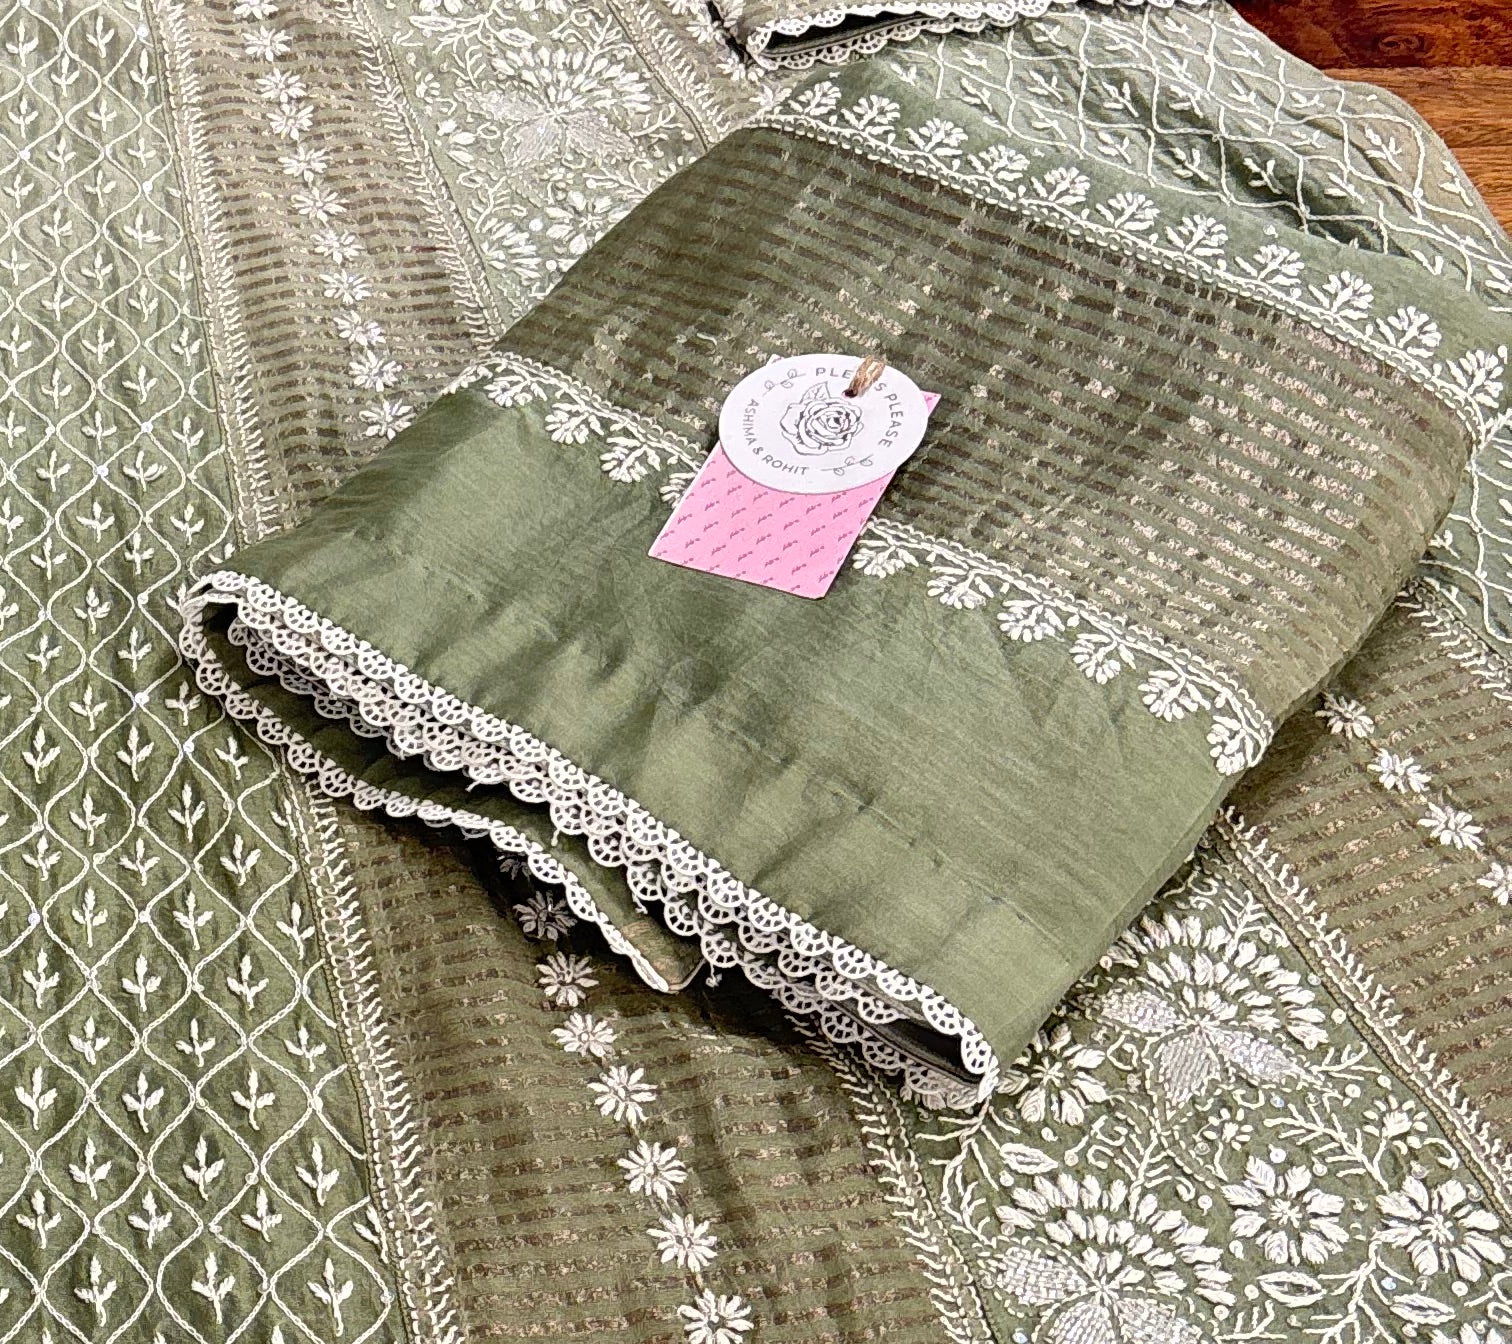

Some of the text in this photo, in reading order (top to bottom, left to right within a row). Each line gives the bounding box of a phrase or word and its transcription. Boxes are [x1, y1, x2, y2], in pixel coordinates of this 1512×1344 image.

[742, 398, 810, 475] ASHIMA & ROHIT
[815, 367, 904, 448] PLES PLEASE
